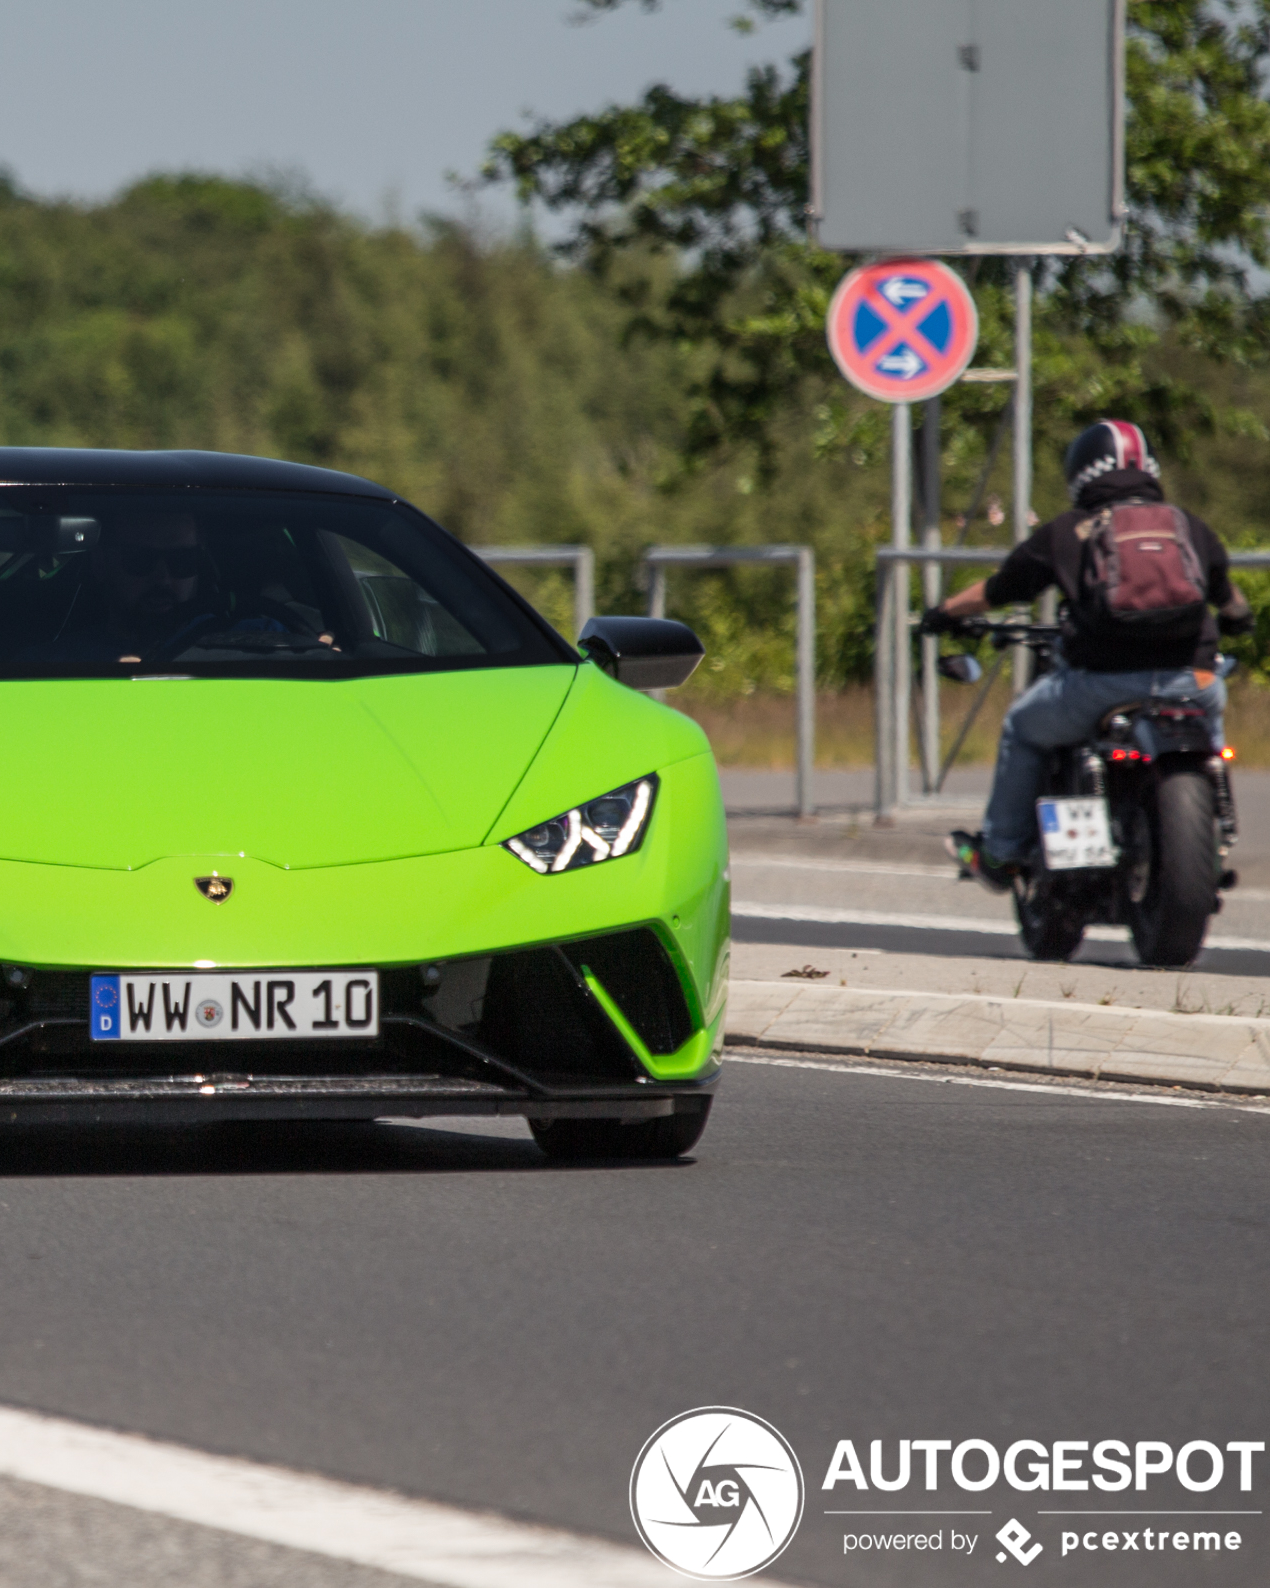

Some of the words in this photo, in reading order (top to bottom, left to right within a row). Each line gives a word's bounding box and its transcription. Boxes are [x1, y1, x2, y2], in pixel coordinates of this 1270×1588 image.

[127, 981, 191, 1032] WW
[232, 980, 297, 1030] NR
[312, 979, 373, 1030] 10
[100, 1015, 112, 1031] D
